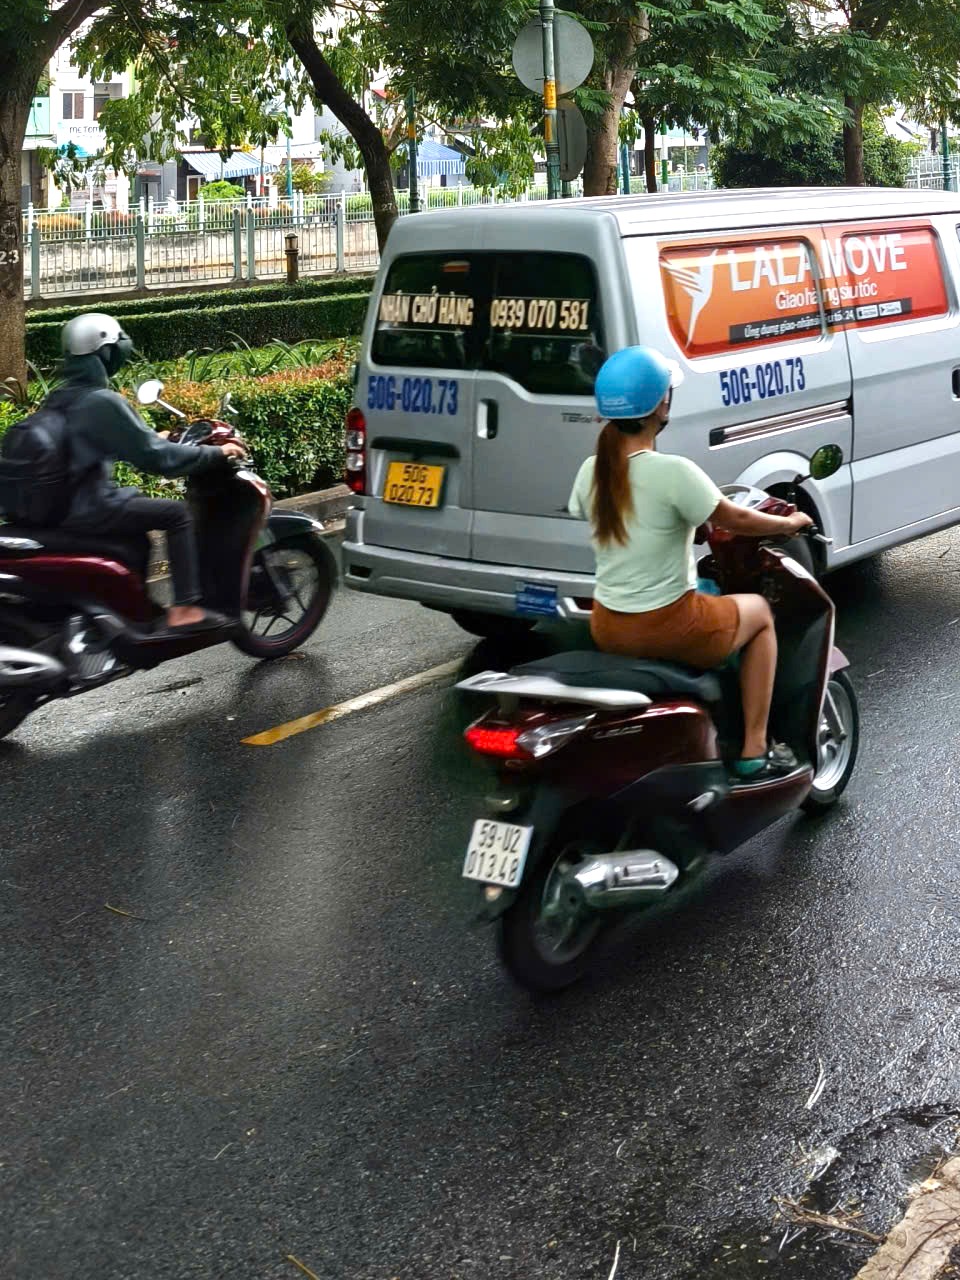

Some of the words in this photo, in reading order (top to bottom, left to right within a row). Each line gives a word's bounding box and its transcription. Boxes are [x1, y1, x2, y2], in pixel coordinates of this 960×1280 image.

[728, 233, 907, 291] LALAMOVE
[775, 285, 803, 310] Giao
[490, 298, 525, 328] 0939
[528, 300, 556, 329] 070
[559, 300, 588, 330] 581
[367, 375, 459, 415] 50G-020.73
[720, 357, 806, 407] 50G-020.73
[403, 465, 429, 483] 50G
[390, 484, 434, 505] 020.73
